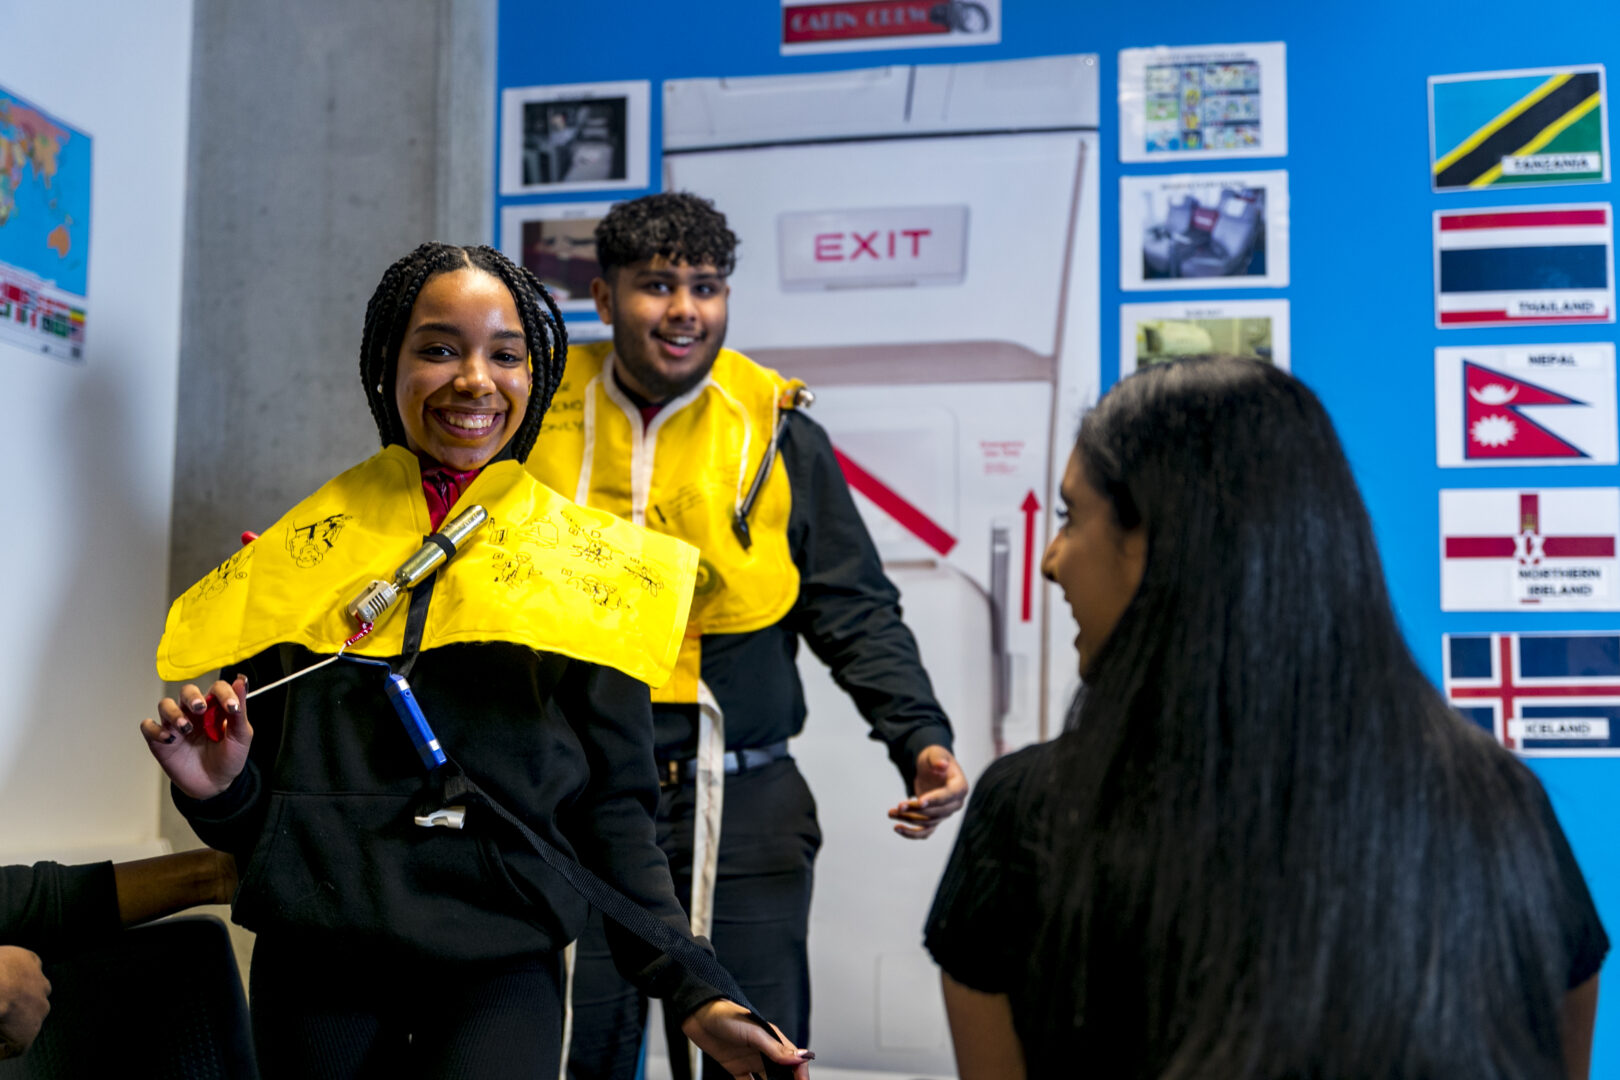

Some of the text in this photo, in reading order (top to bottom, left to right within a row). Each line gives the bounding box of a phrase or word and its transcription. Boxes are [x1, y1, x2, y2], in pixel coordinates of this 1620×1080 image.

[791, 6, 927, 33] CABIN CREW
[1514, 158, 1589, 170] TANZANIA
[814, 228, 931, 262] EXIT
[1518, 300, 1595, 313] THAILAND
[1529, 353, 1577, 366] NEPAL
[1518, 567, 1601, 579] NORTHERN
[1528, 584, 1592, 596] IRELAND
[1525, 723, 1592, 735] ICELAND
